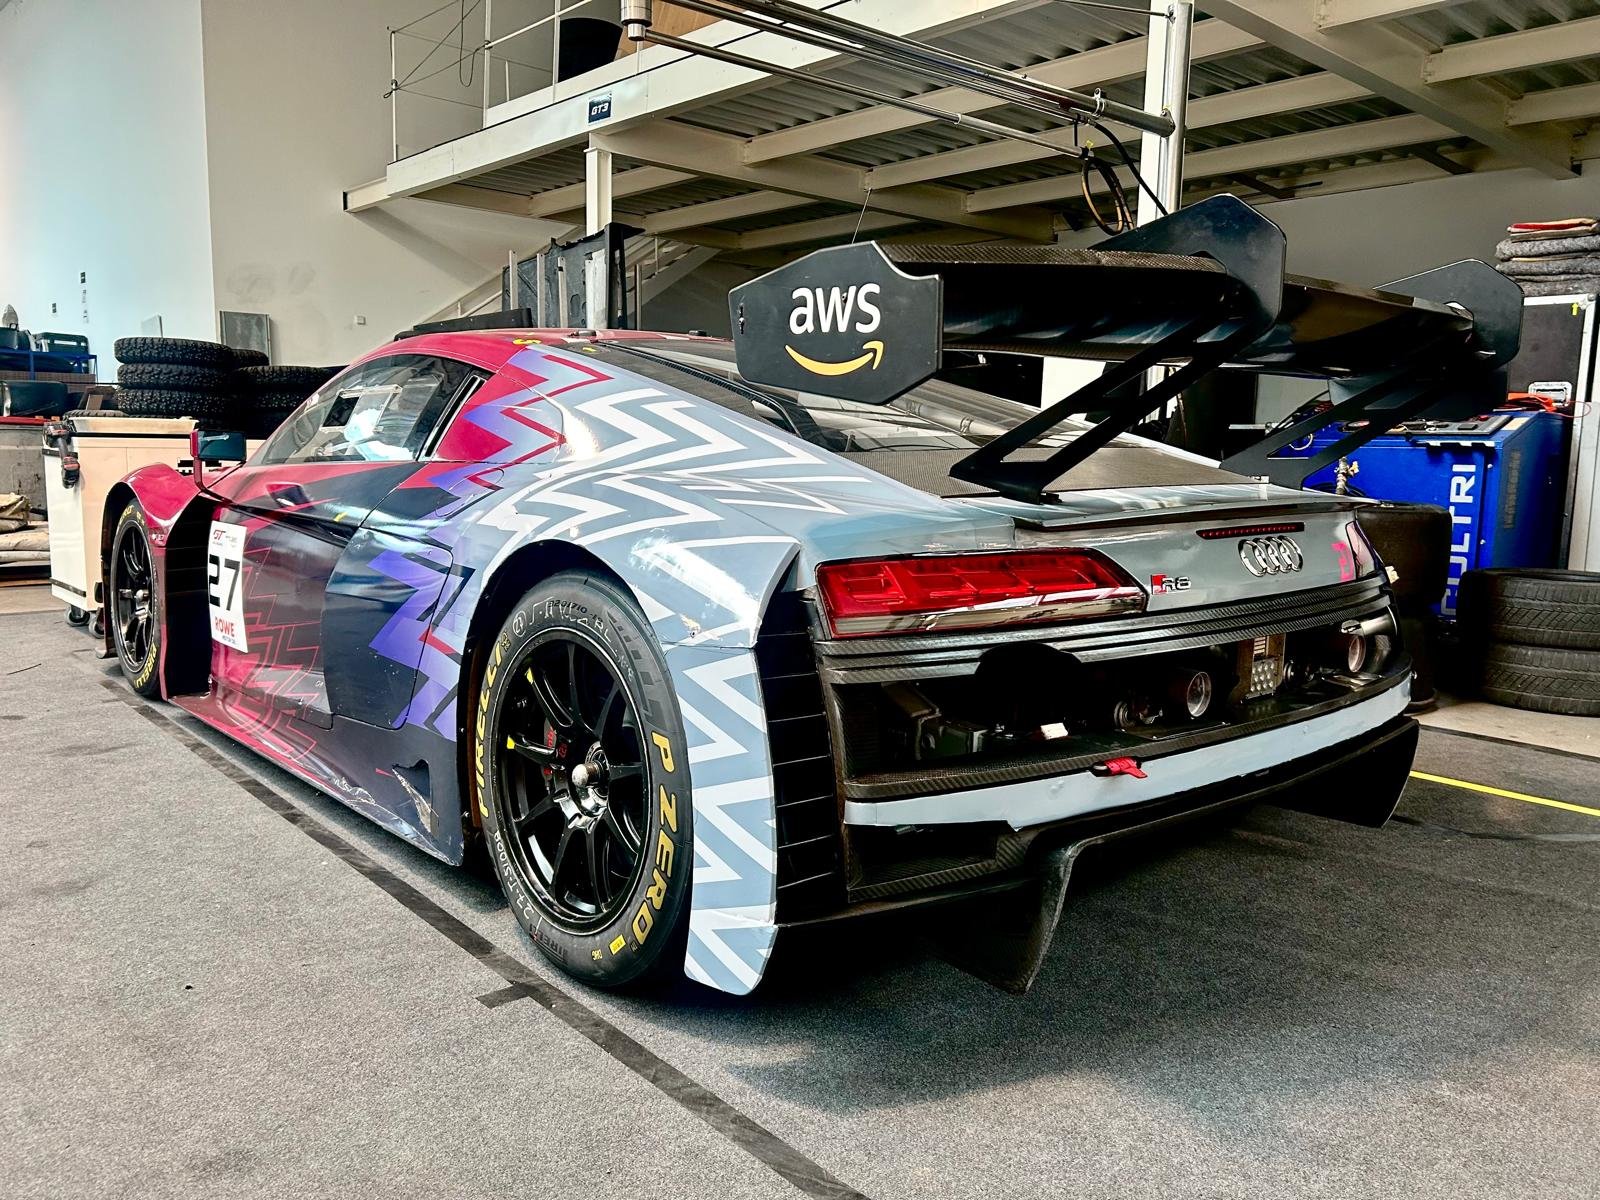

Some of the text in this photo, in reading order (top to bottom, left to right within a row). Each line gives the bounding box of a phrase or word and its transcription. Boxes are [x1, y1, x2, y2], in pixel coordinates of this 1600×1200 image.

[591, 102, 609, 116] GT3
[789, 282, 881, 335] aws
[209, 553, 241, 612] 27
[215, 616, 235, 638] ROWE
[475, 641, 502, 818] PIRELLI
[632, 731, 677, 945] P ZERO
